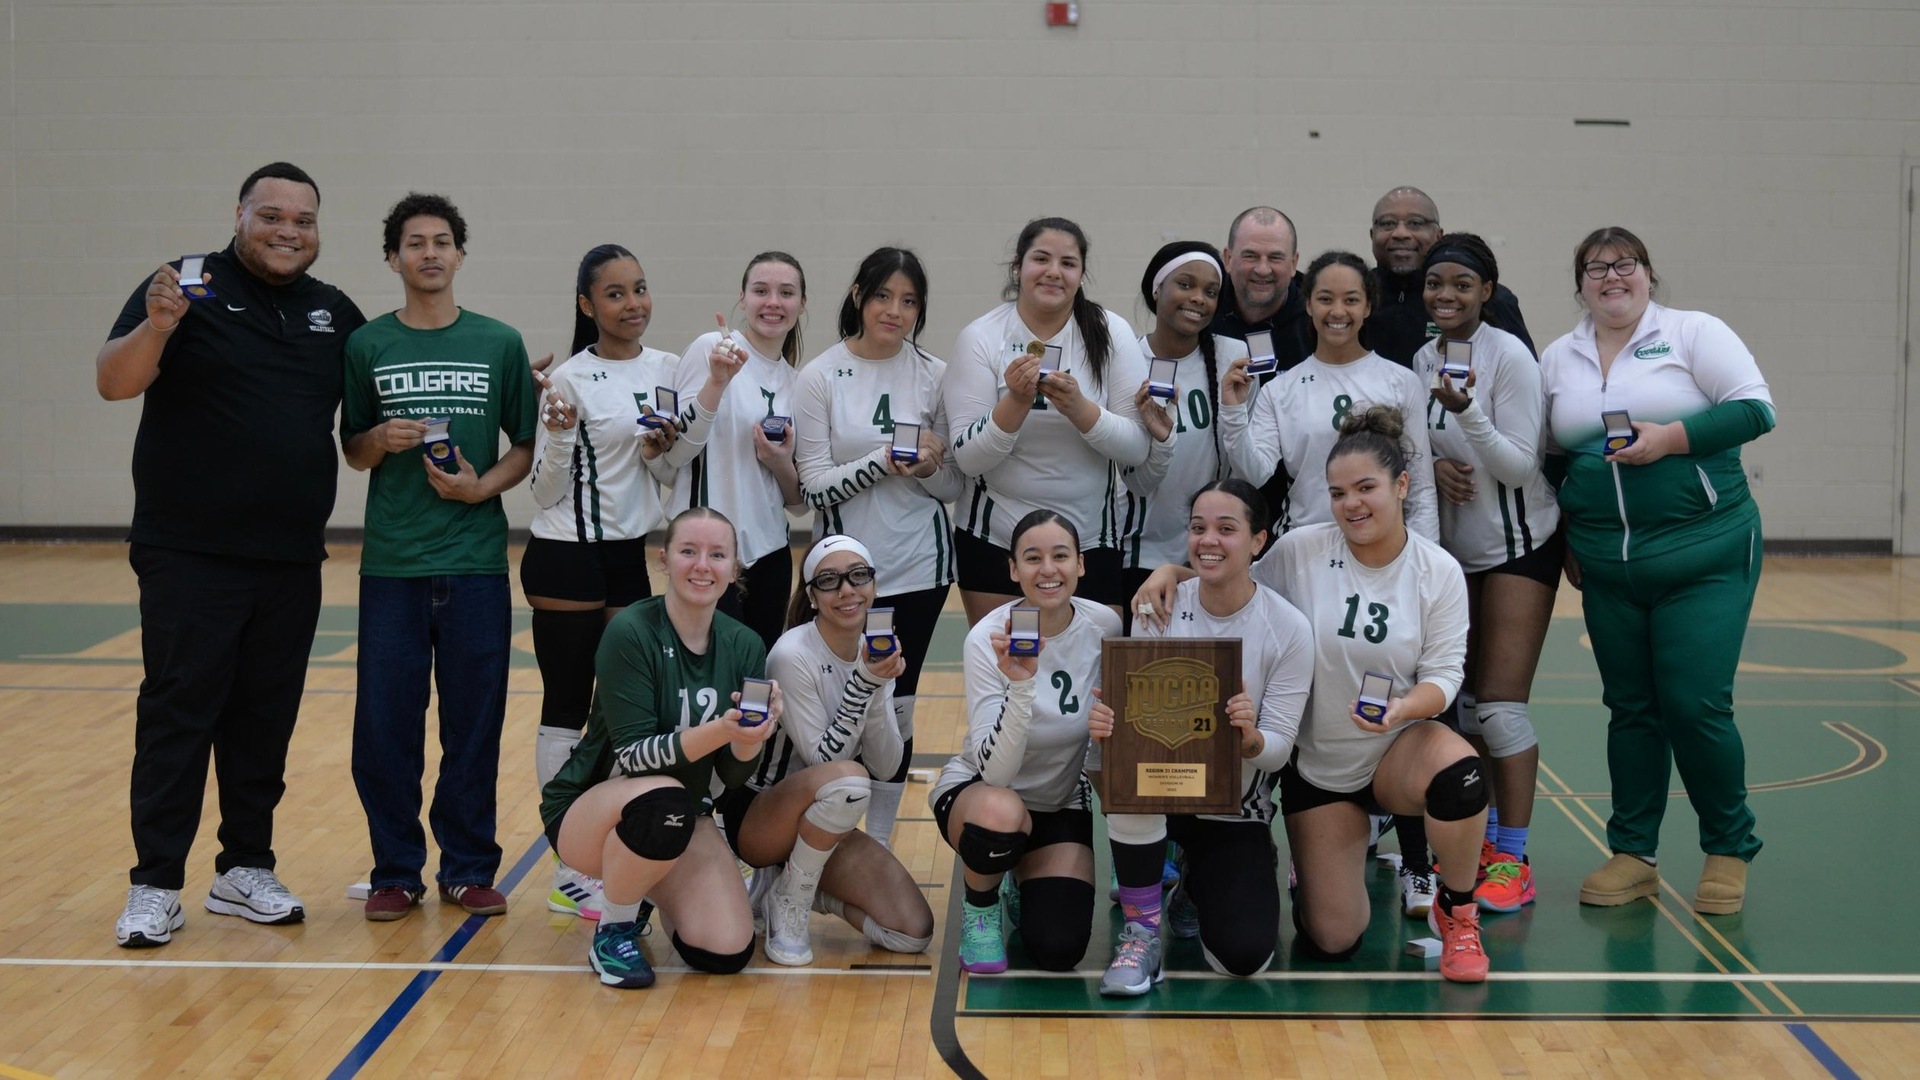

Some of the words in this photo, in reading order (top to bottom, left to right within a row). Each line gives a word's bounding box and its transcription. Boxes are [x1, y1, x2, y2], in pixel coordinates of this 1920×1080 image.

[375, 371, 489, 396] COUGARS
[760, 386, 775, 416] 7
[383, 408, 406, 417] HCC
[408, 406, 486, 416] VOLLEYBALL
[872, 393, 895, 434] 4
[1332, 394, 1353, 431] 8
[1337, 593, 1390, 644] 13
[674, 687, 720, 733] 12
[1051, 670, 1080, 715] 2
[1130, 677, 1216, 716] NJCAA
[1193, 718, 1211, 732] 21
